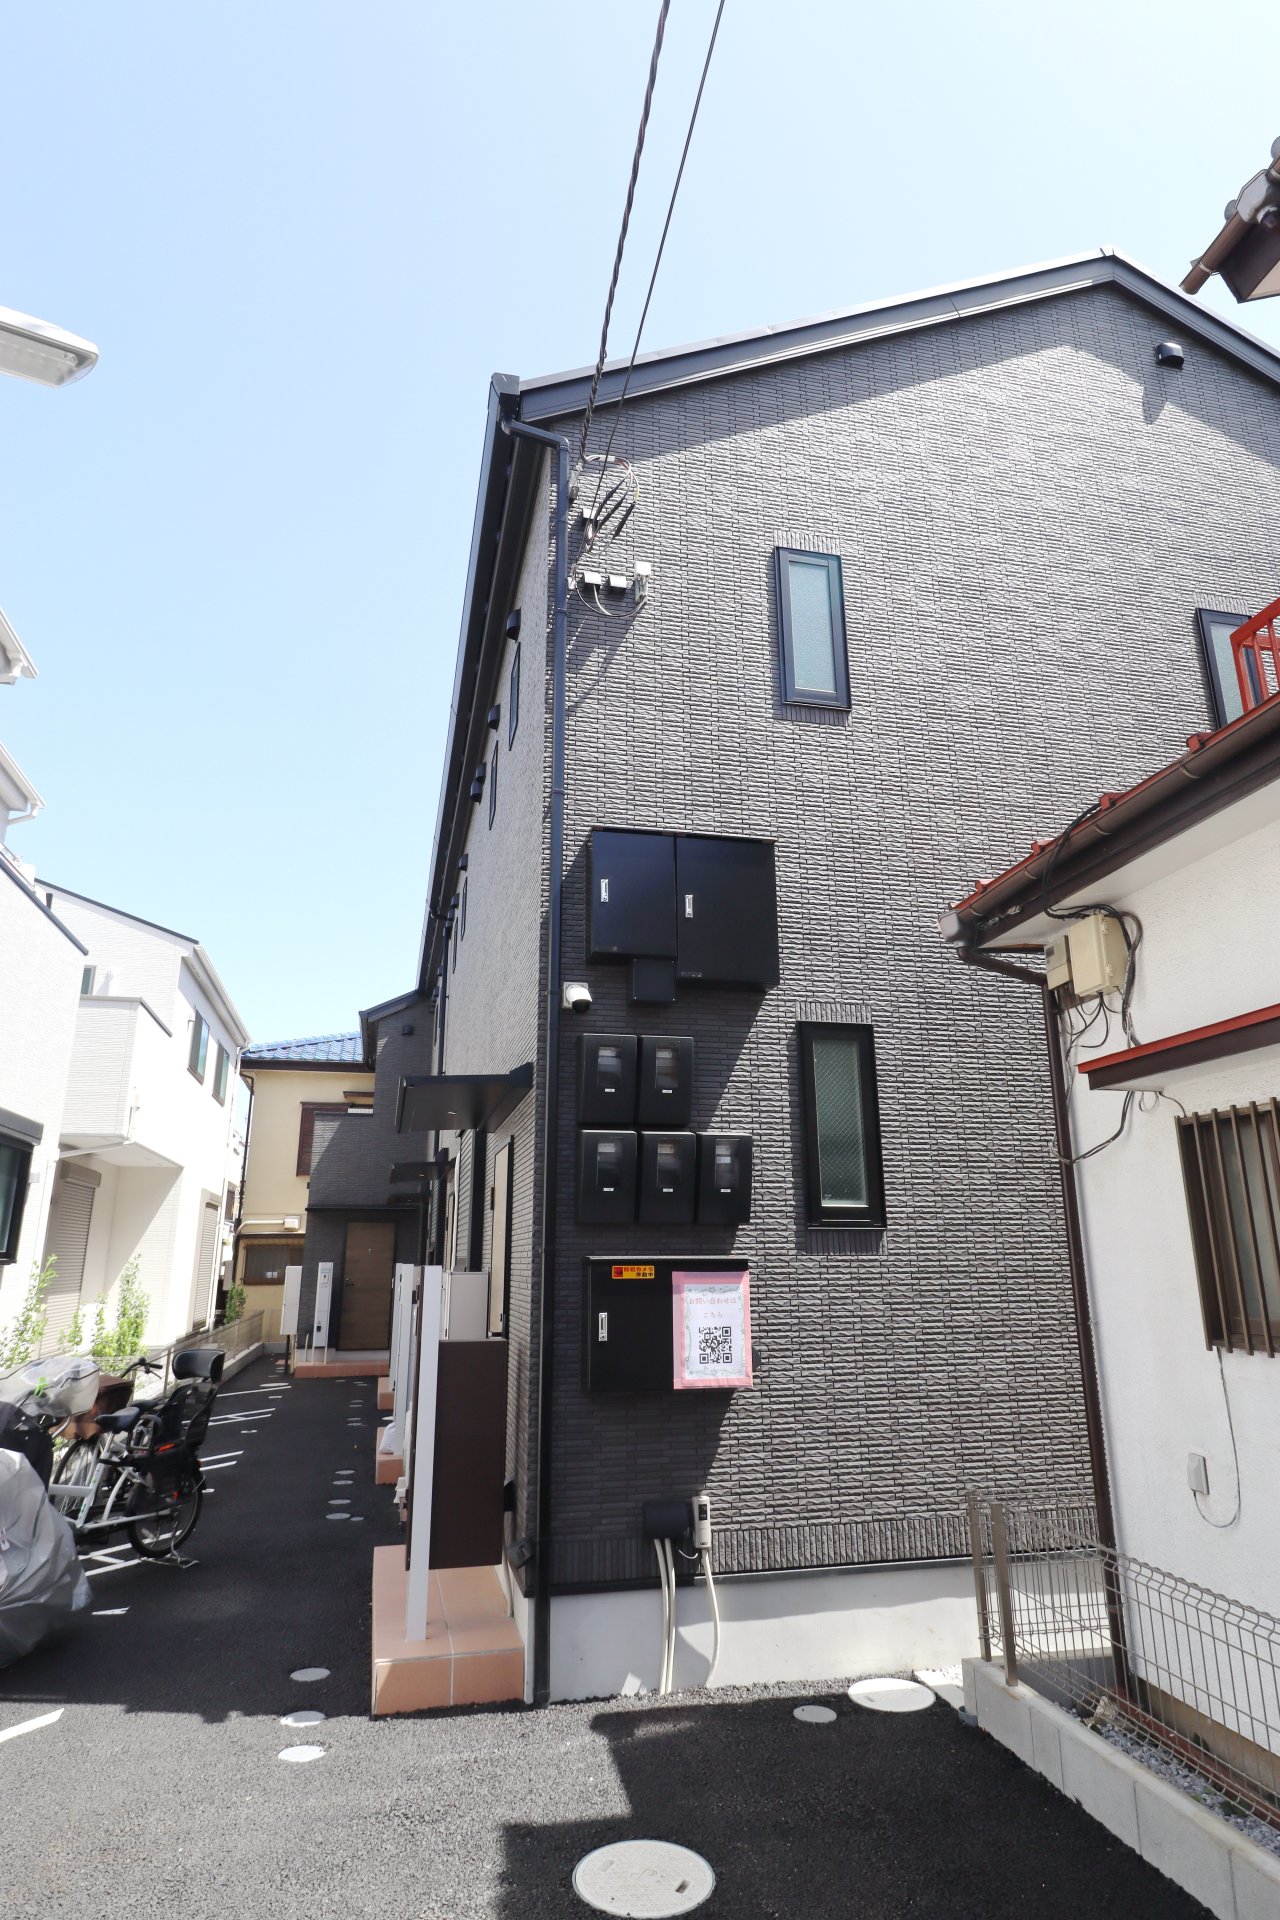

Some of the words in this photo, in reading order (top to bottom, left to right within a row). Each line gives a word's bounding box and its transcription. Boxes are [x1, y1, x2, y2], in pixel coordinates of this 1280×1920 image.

[689, 1297, 736, 1305] お問い合わせは
